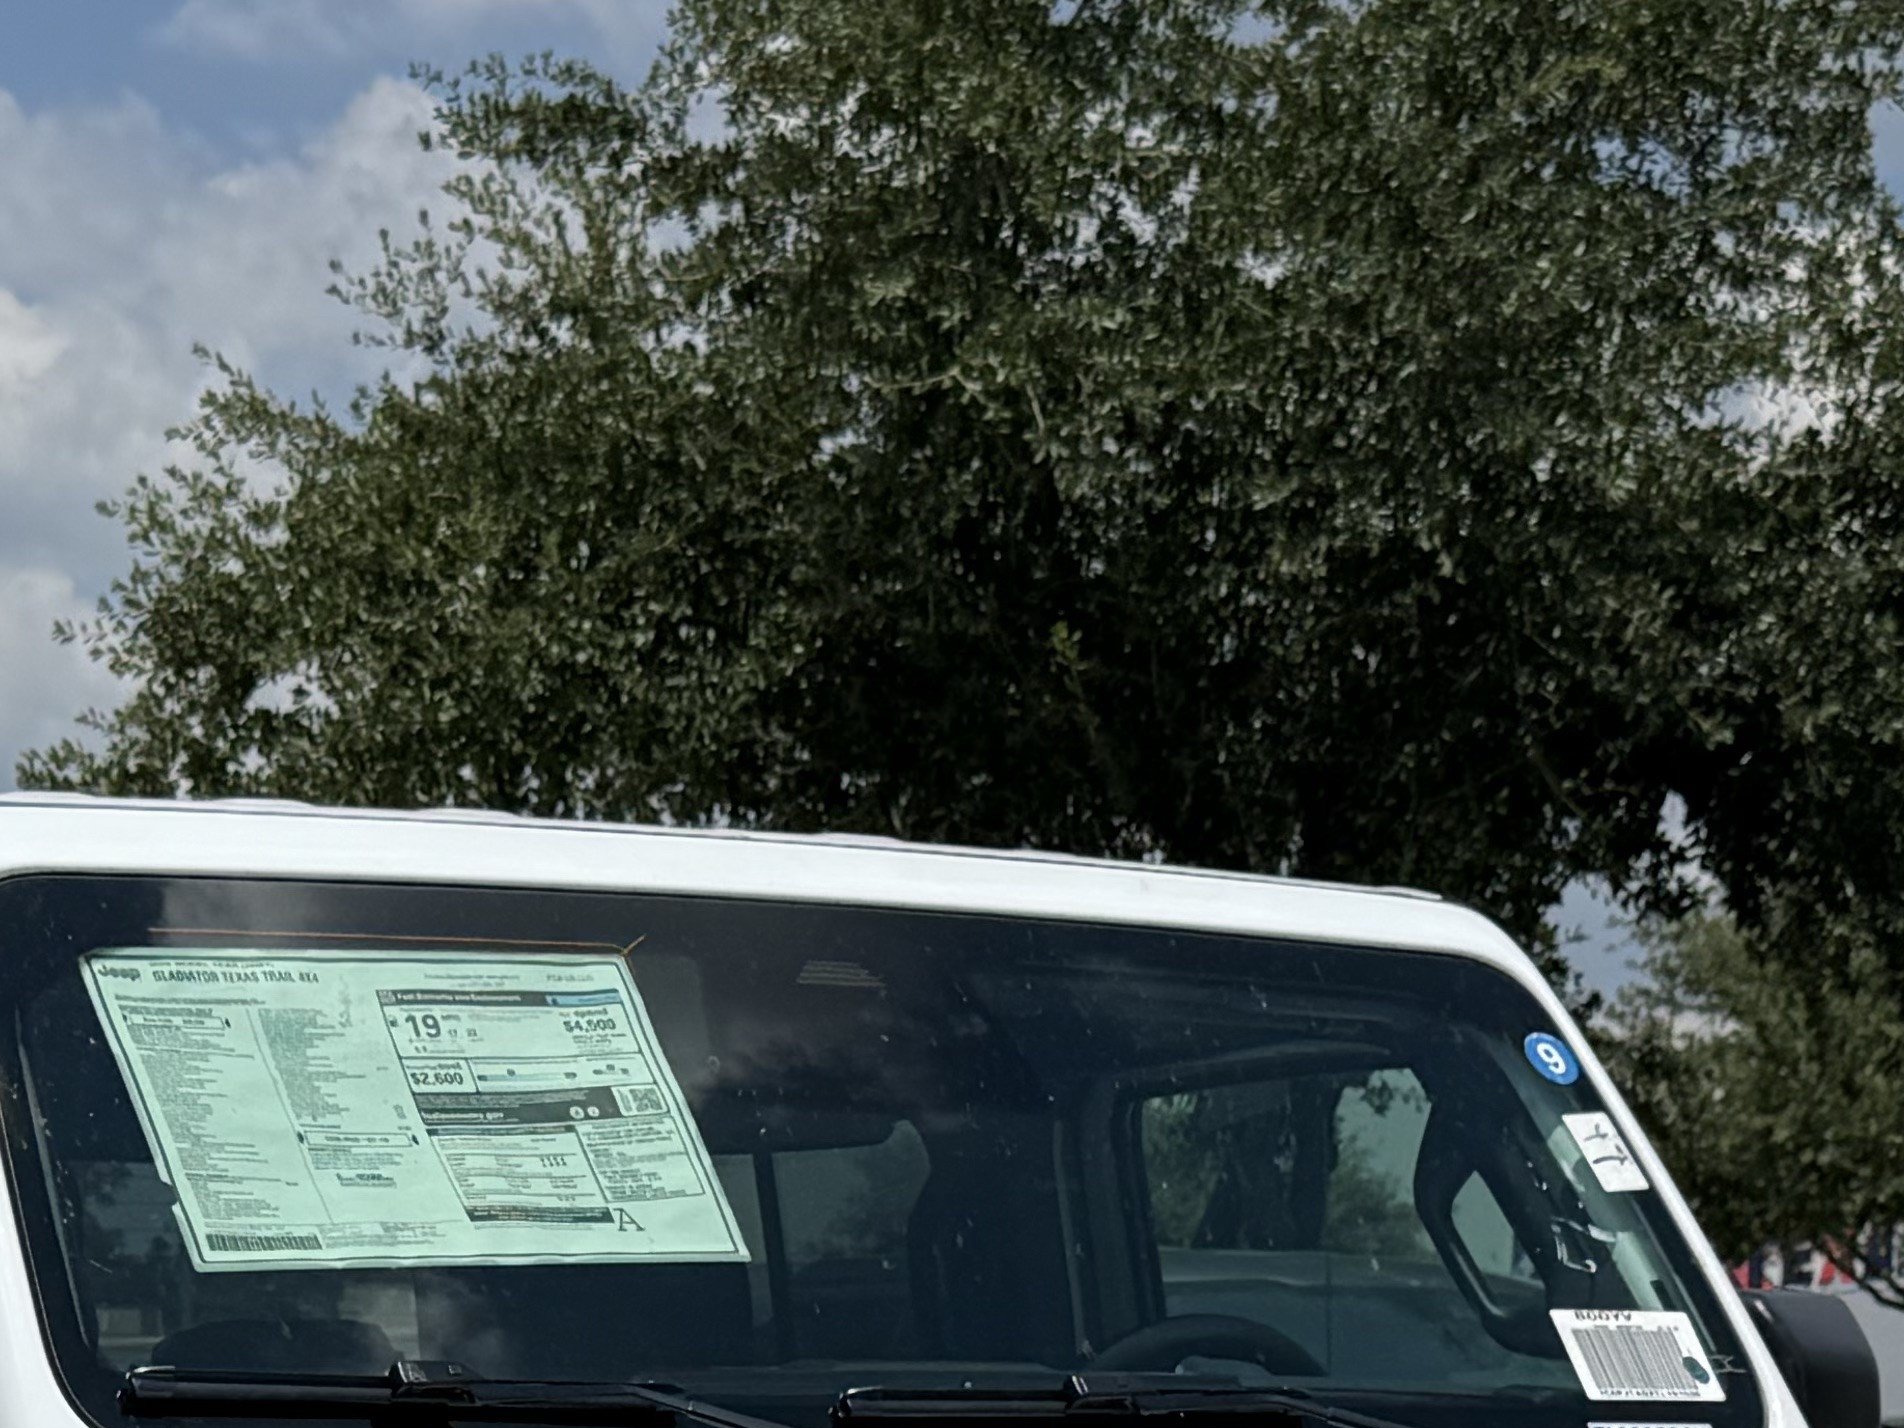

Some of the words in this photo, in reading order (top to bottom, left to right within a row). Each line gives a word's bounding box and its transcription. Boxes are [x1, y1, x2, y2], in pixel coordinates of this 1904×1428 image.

[152, 970, 220, 983] GLADIATOR
[221, 971, 260, 984] TEXAS
[261, 970, 296, 983] TRAIL
[405, 1014, 441, 1038] 19
[410, 1072, 463, 1085] $2,600
[612, 1208, 646, 1231] A
